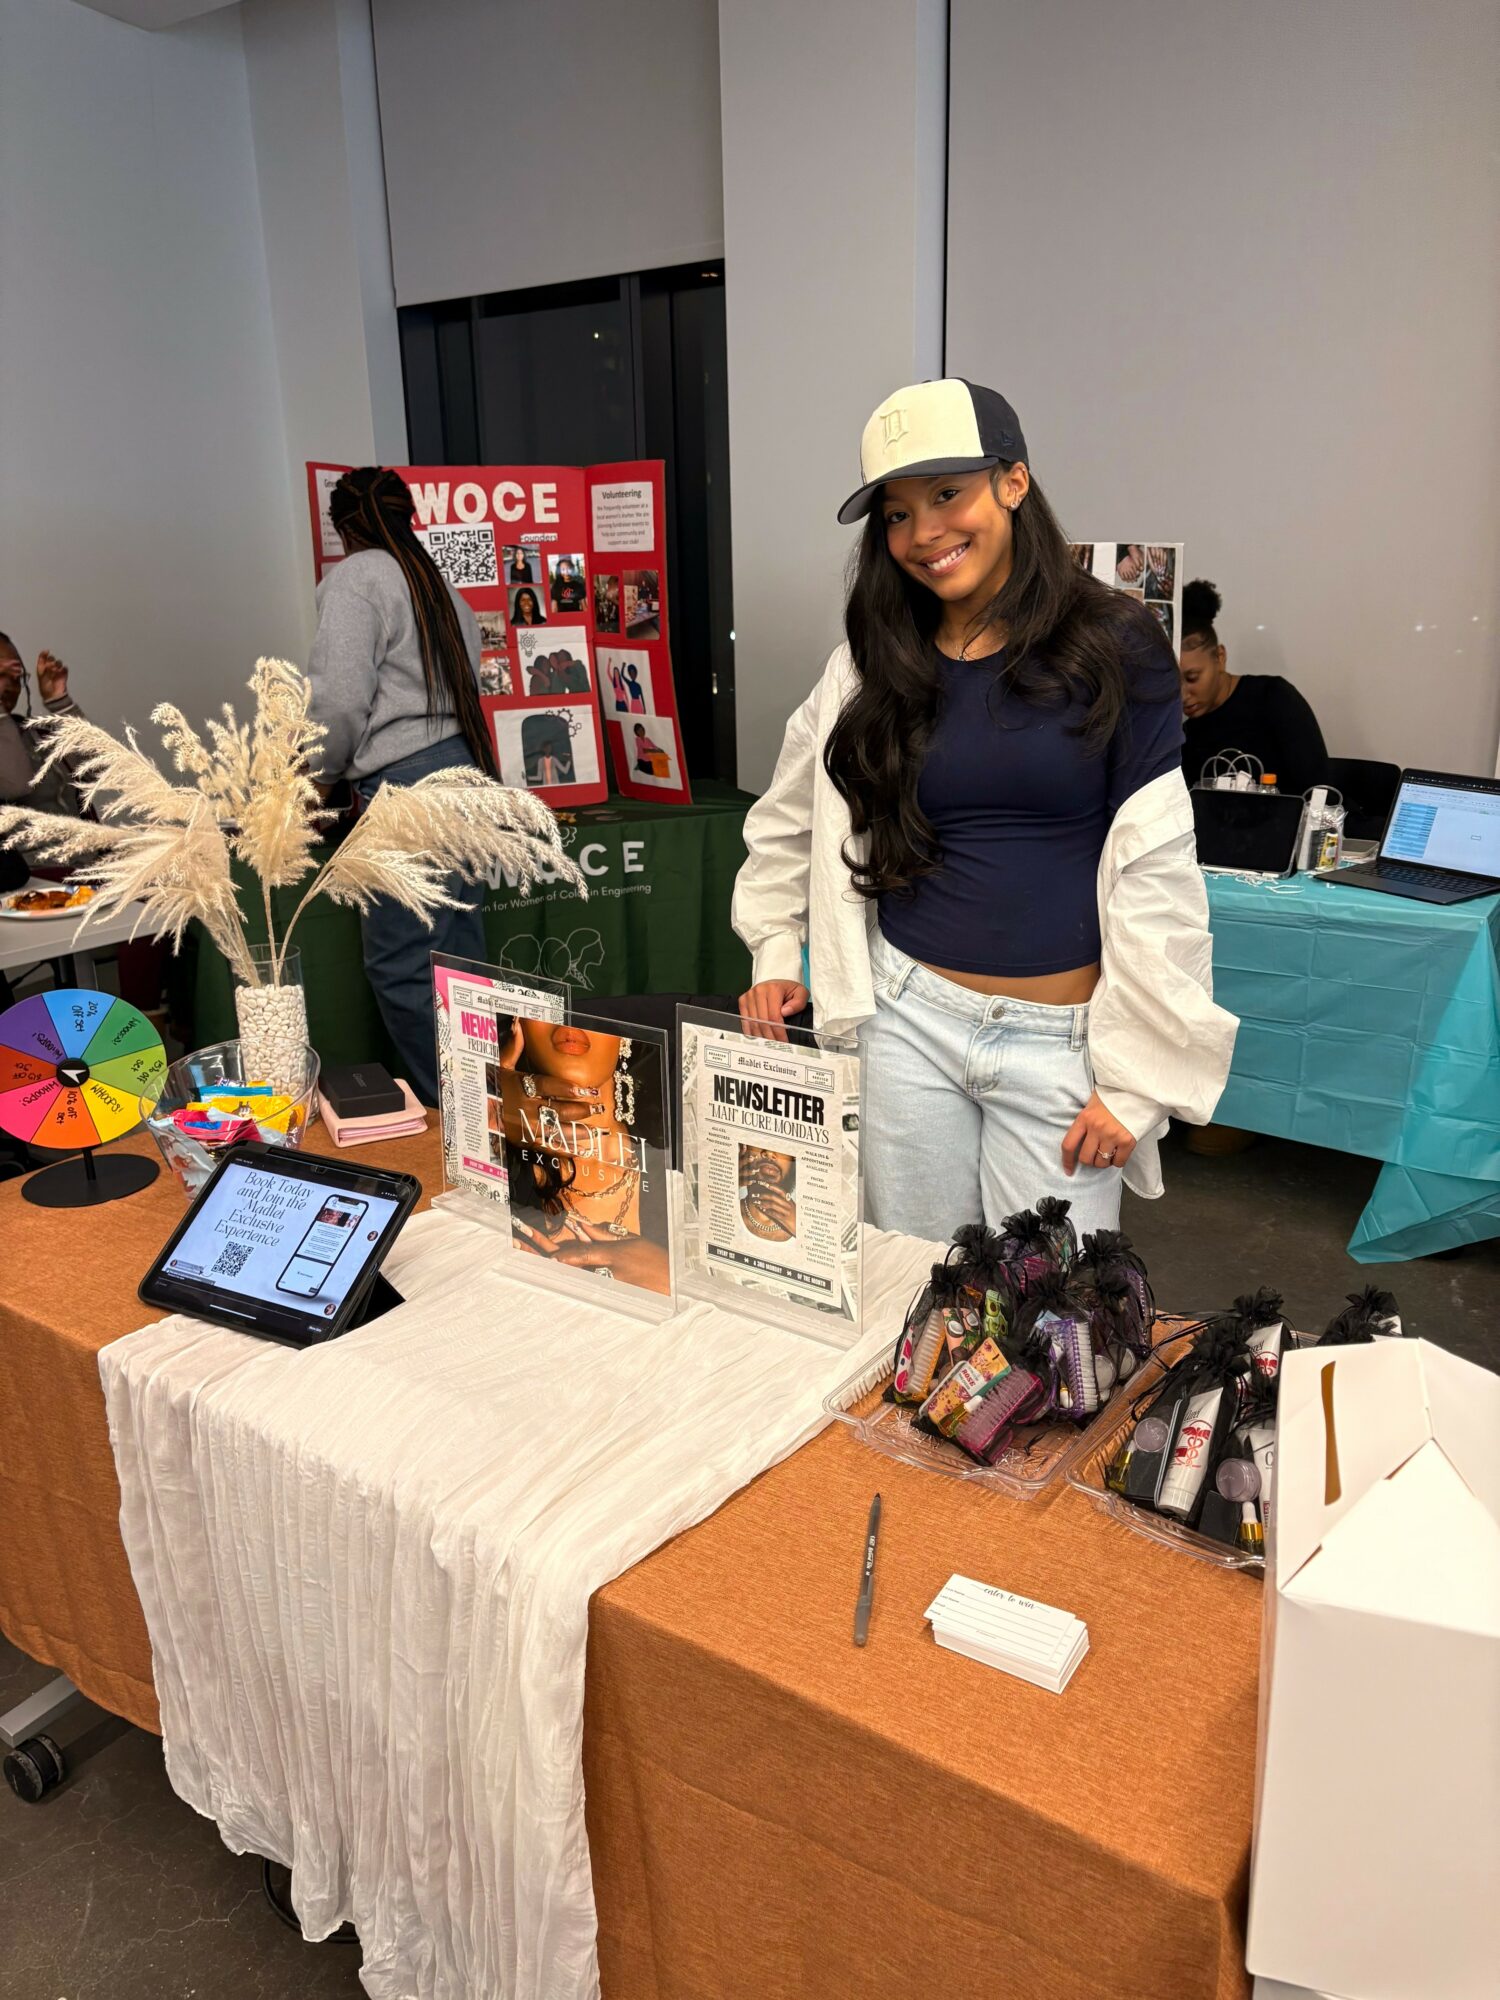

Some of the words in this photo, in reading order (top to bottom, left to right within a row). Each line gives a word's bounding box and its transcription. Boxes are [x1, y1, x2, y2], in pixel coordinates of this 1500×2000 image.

[409, 481, 560, 525] WOCE
[602, 489, 642, 499] Volunteering
[521, 533, 558, 543] ounders
[494, 902, 508, 911] for
[511, 895, 545, 908] Women
[547, 892, 556, 901] of
[560, 889, 583, 899] Colo
[590, 889, 599, 897] in
[87, 1001, 98, 1017] 20%
[461, 1011, 498, 1043] NEWS
[149, 1060, 164, 1073] 15%
[738, 1056, 762, 1069] Madlei
[763, 1061, 797, 1077] Exclusive
[19, 1081, 59, 1107] WHOOPS!
[67, 1091, 78, 1105] 10%
[90, 1084, 124, 1113] WHOOPS!
[713, 1074, 825, 1126] NEWSLETTER
[708, 1103, 738, 1122] "MAN"
[741, 1111, 772, 1131] ICURE
[774, 1118, 829, 1144] MONDAYS
[519, 1108, 648, 1173] MADLEI
[244, 1171, 276, 1190] Book
[278, 1177, 315, 1199] Today
[236, 1187, 263, 1200] and
[261, 1189, 285, 1206] Join
[285, 1196, 307, 1211] the
[243, 1199, 286, 1220] Madlei
[214, 1219, 280, 1247] Experience
[228, 1208, 285, 1234] Exclusive
[961, 1368, 977, 1387] ROSE
[984, 1587, 1006, 1600] enter
[1008, 1595, 1016, 1603] to
[1018, 1598, 1034, 1610] win
